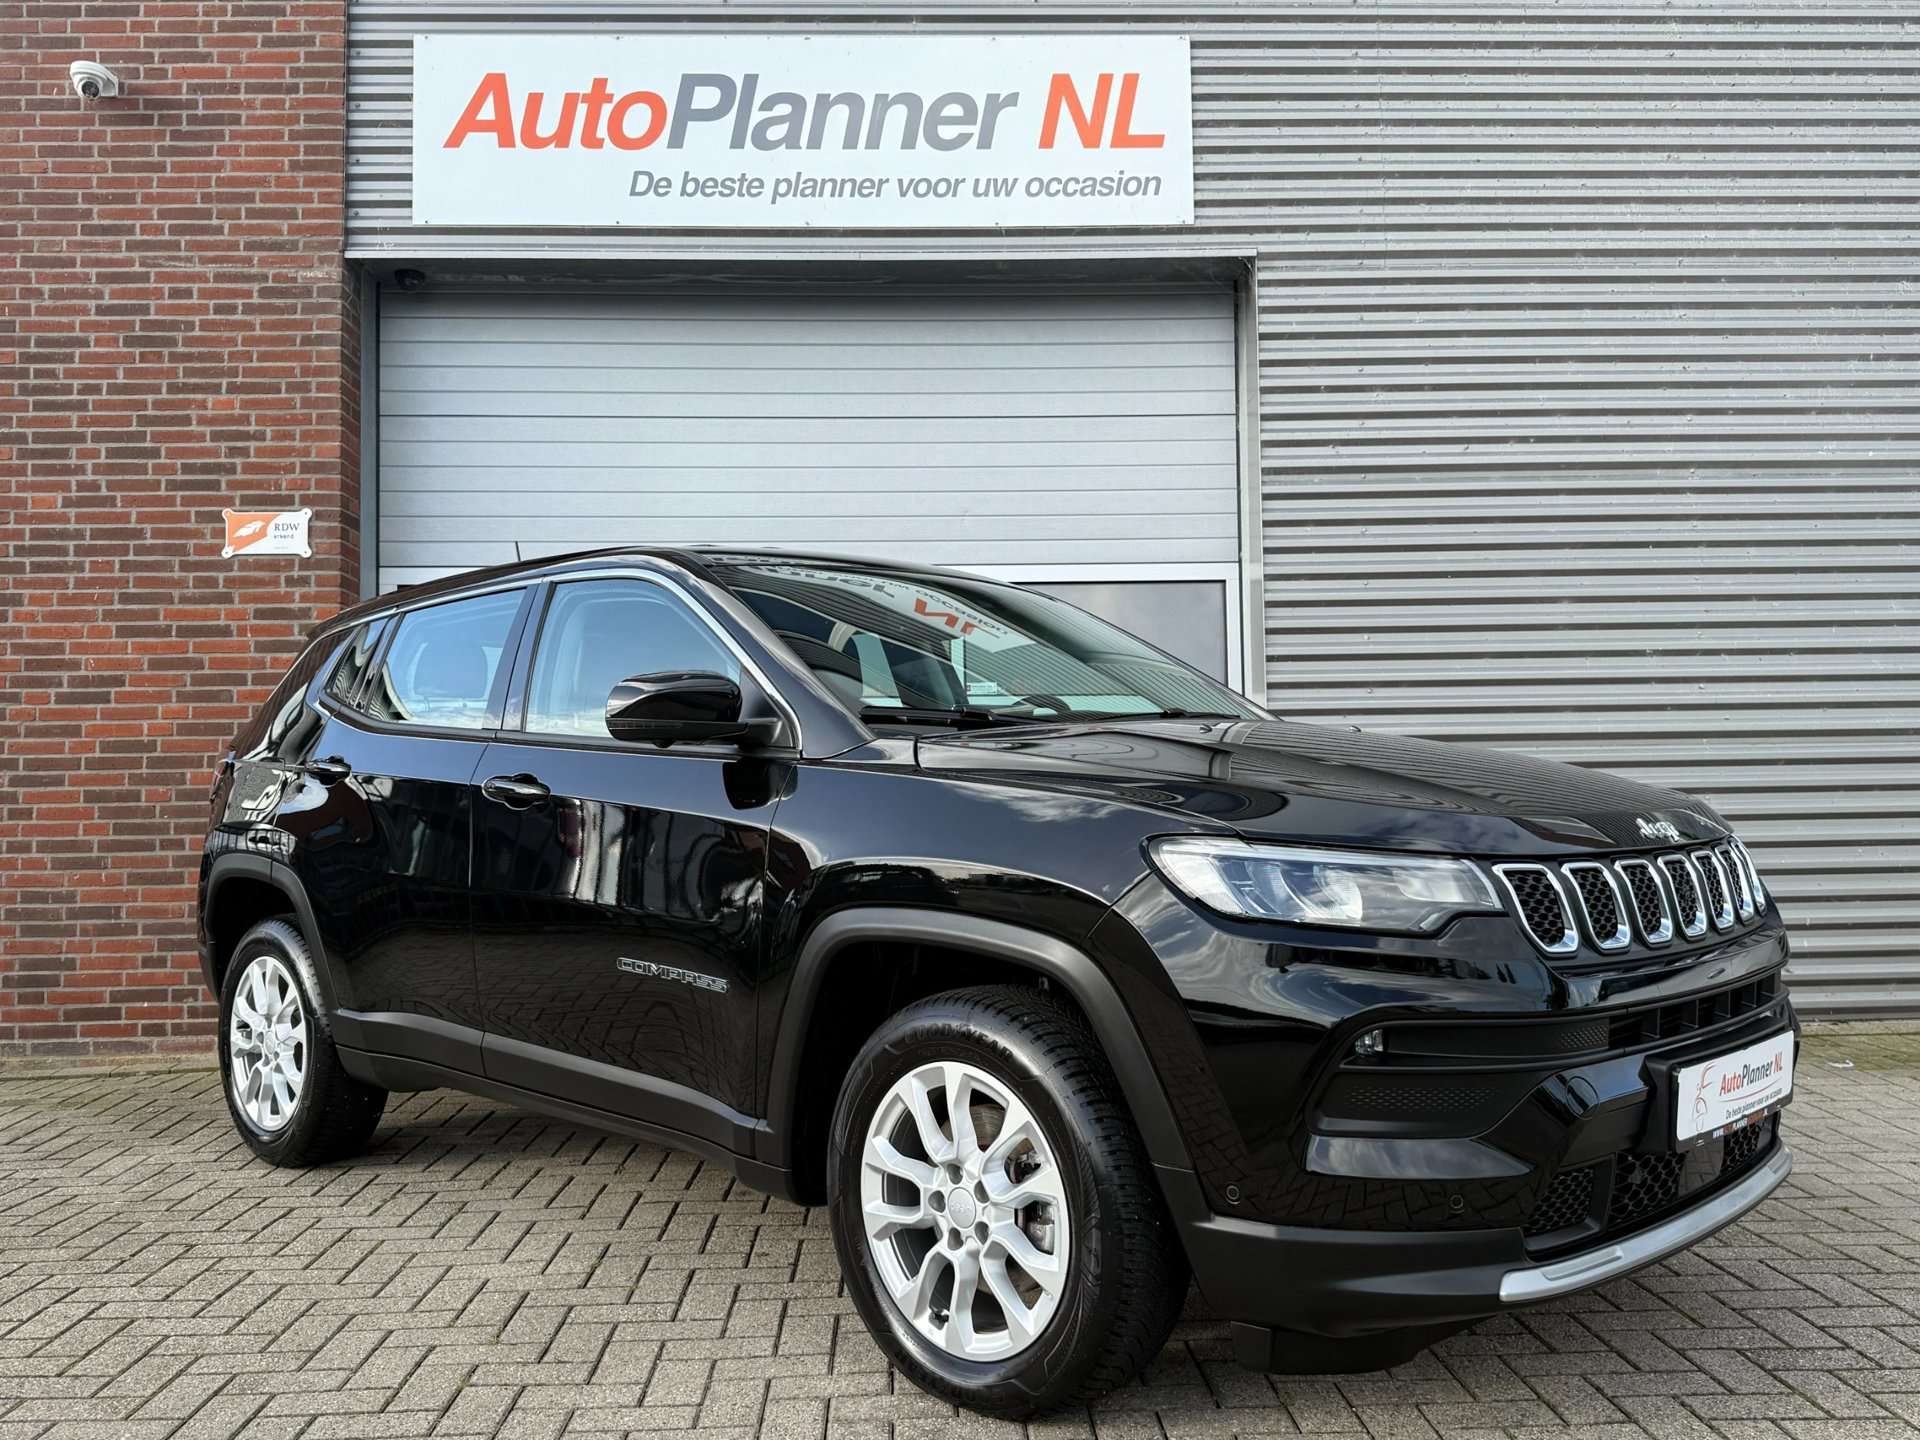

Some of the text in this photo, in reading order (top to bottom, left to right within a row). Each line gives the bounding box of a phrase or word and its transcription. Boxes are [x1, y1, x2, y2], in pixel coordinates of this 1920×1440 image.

[443, 73, 1165, 151] AutoPlanner NL
[629, 170, 1161, 205] De beste planner voor uw occasion
[274, 522, 299, 532] RDW
[616, 956, 729, 994] COMPASS
[1719, 1050, 1783, 1097] AutoPlanner NL
